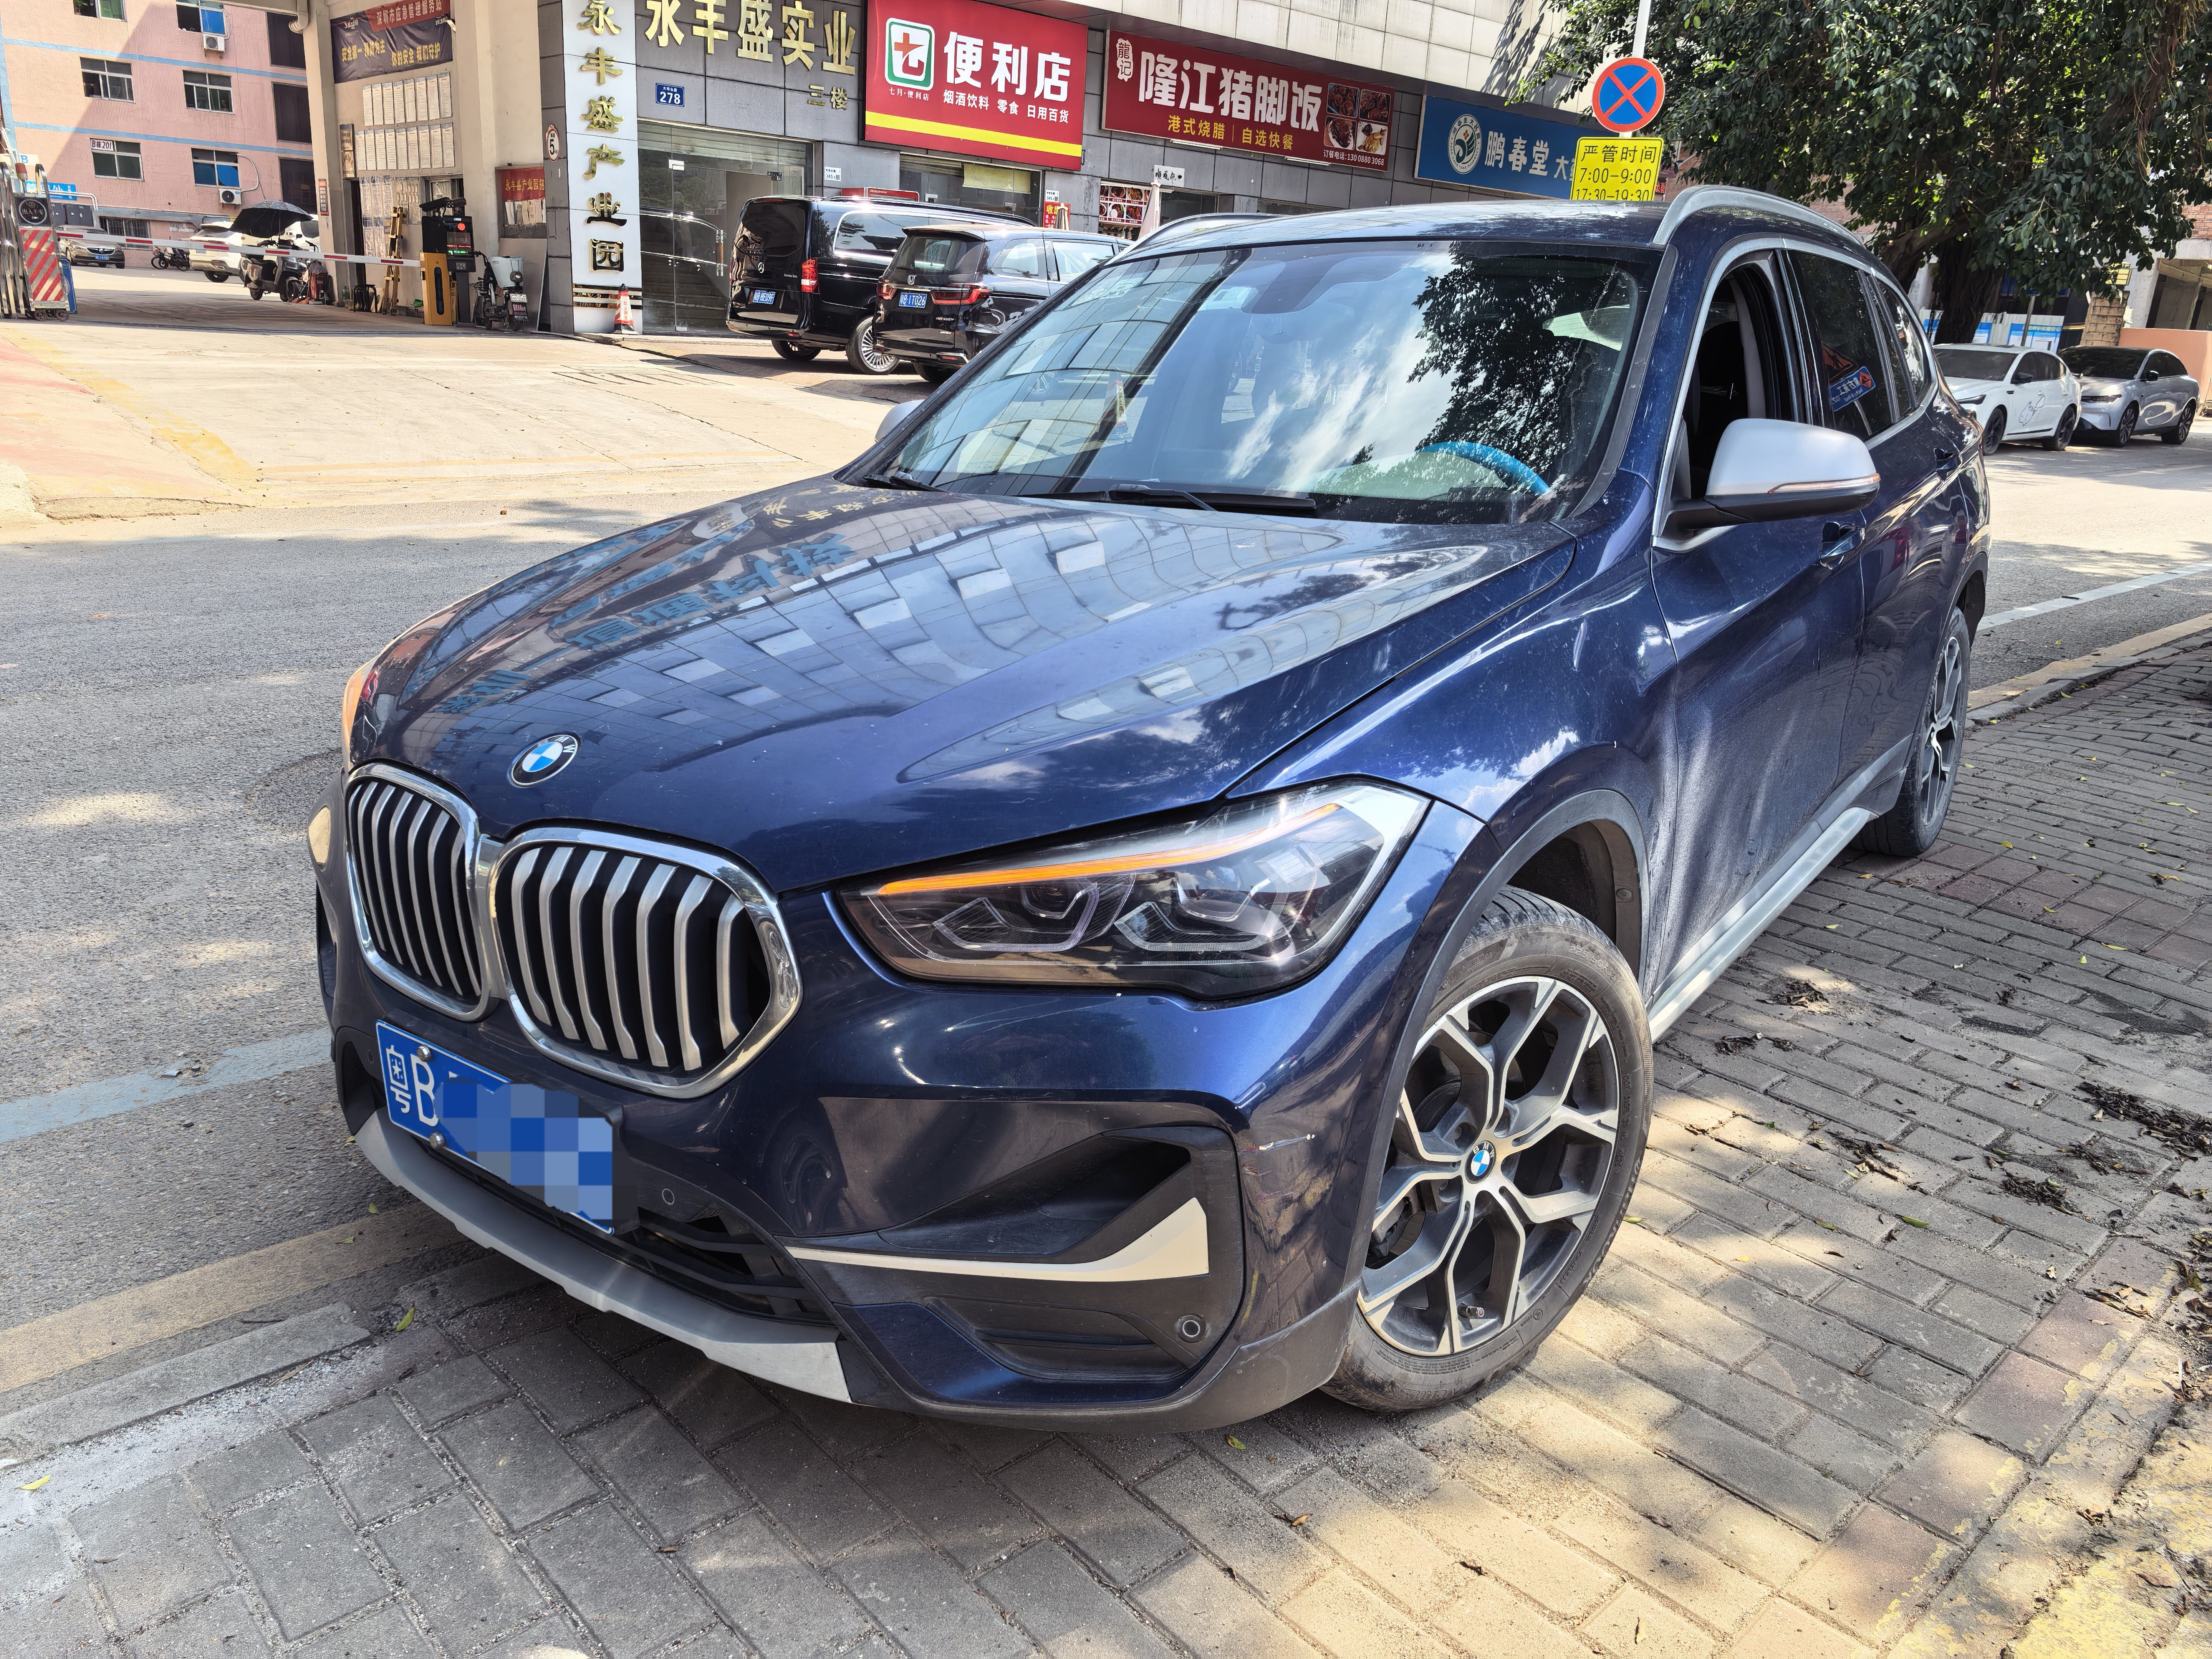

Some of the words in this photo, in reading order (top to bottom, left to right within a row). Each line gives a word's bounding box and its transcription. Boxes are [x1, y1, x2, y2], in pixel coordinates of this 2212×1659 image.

[943, 31, 1071, 102] 便利店
[660, 91, 680, 104] 278
[807, 84, 848, 110] 三楼
[1138, 50, 1323, 132] 隆江猪脚饭
[943, 89, 989, 111] 烟酒饮料
[997, 99, 1019, 116] 零食
[1027, 104, 1069, 124] 日用百货
[1167, 114, 1225, 140] 港式烧腊
[1241, 127, 1293, 151] 自选快餐
[1358, 155, 1371, 164] 0880
[1371, 157, 1384, 166] 3068
[1485, 131, 1550, 177] 鹏春堂
[1554, 156, 1575, 181] 大
[1581, 145, 1657, 163] 严管时间
[1473, 1142, 1495, 1158] BMW
